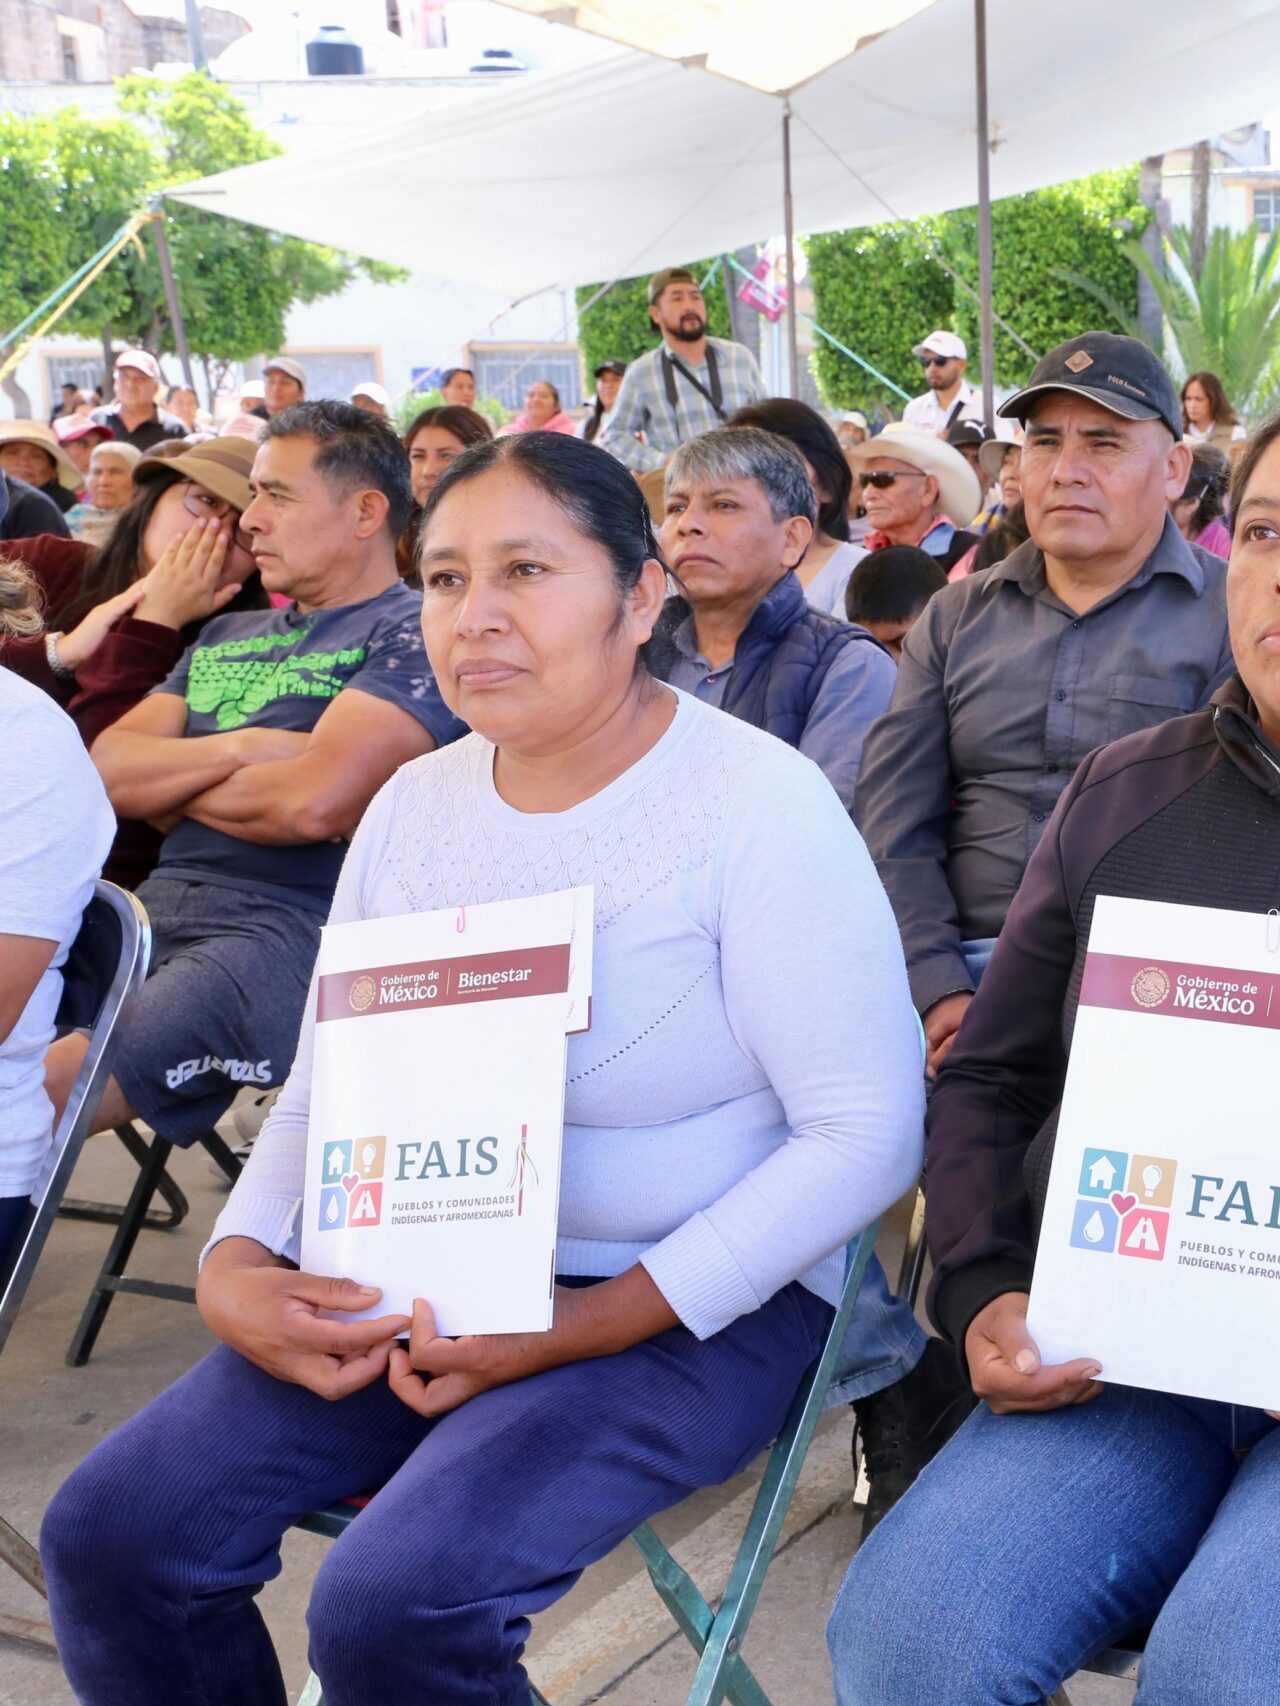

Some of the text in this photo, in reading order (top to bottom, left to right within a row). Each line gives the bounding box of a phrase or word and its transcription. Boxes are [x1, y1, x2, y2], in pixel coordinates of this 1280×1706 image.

[1107, 374, 1123, 386] POLO
[380, 970, 439, 987] Gobierno de
[458, 968, 532, 988] Bienestar
[1177, 974, 1258, 995] Gobierno de
[378, 983, 438, 1004] México
[1173, 985, 1255, 1016] México
[166, 1055, 272, 1089] STARTER
[394, 1136, 498, 1181] FAIS
[392, 1195, 515, 1211] PUEBLOS Y COMUNIDADES
[391, 1209, 514, 1225] INDÍGENAS Y AFROMEXICANAS
[1180, 1240, 1234, 1257] PUEBLOS
[1238, 1249, 1245, 1258] Y
[1178, 1255, 1237, 1273] INDÍGENAS
[1239, 1265, 1246, 1274] Y
